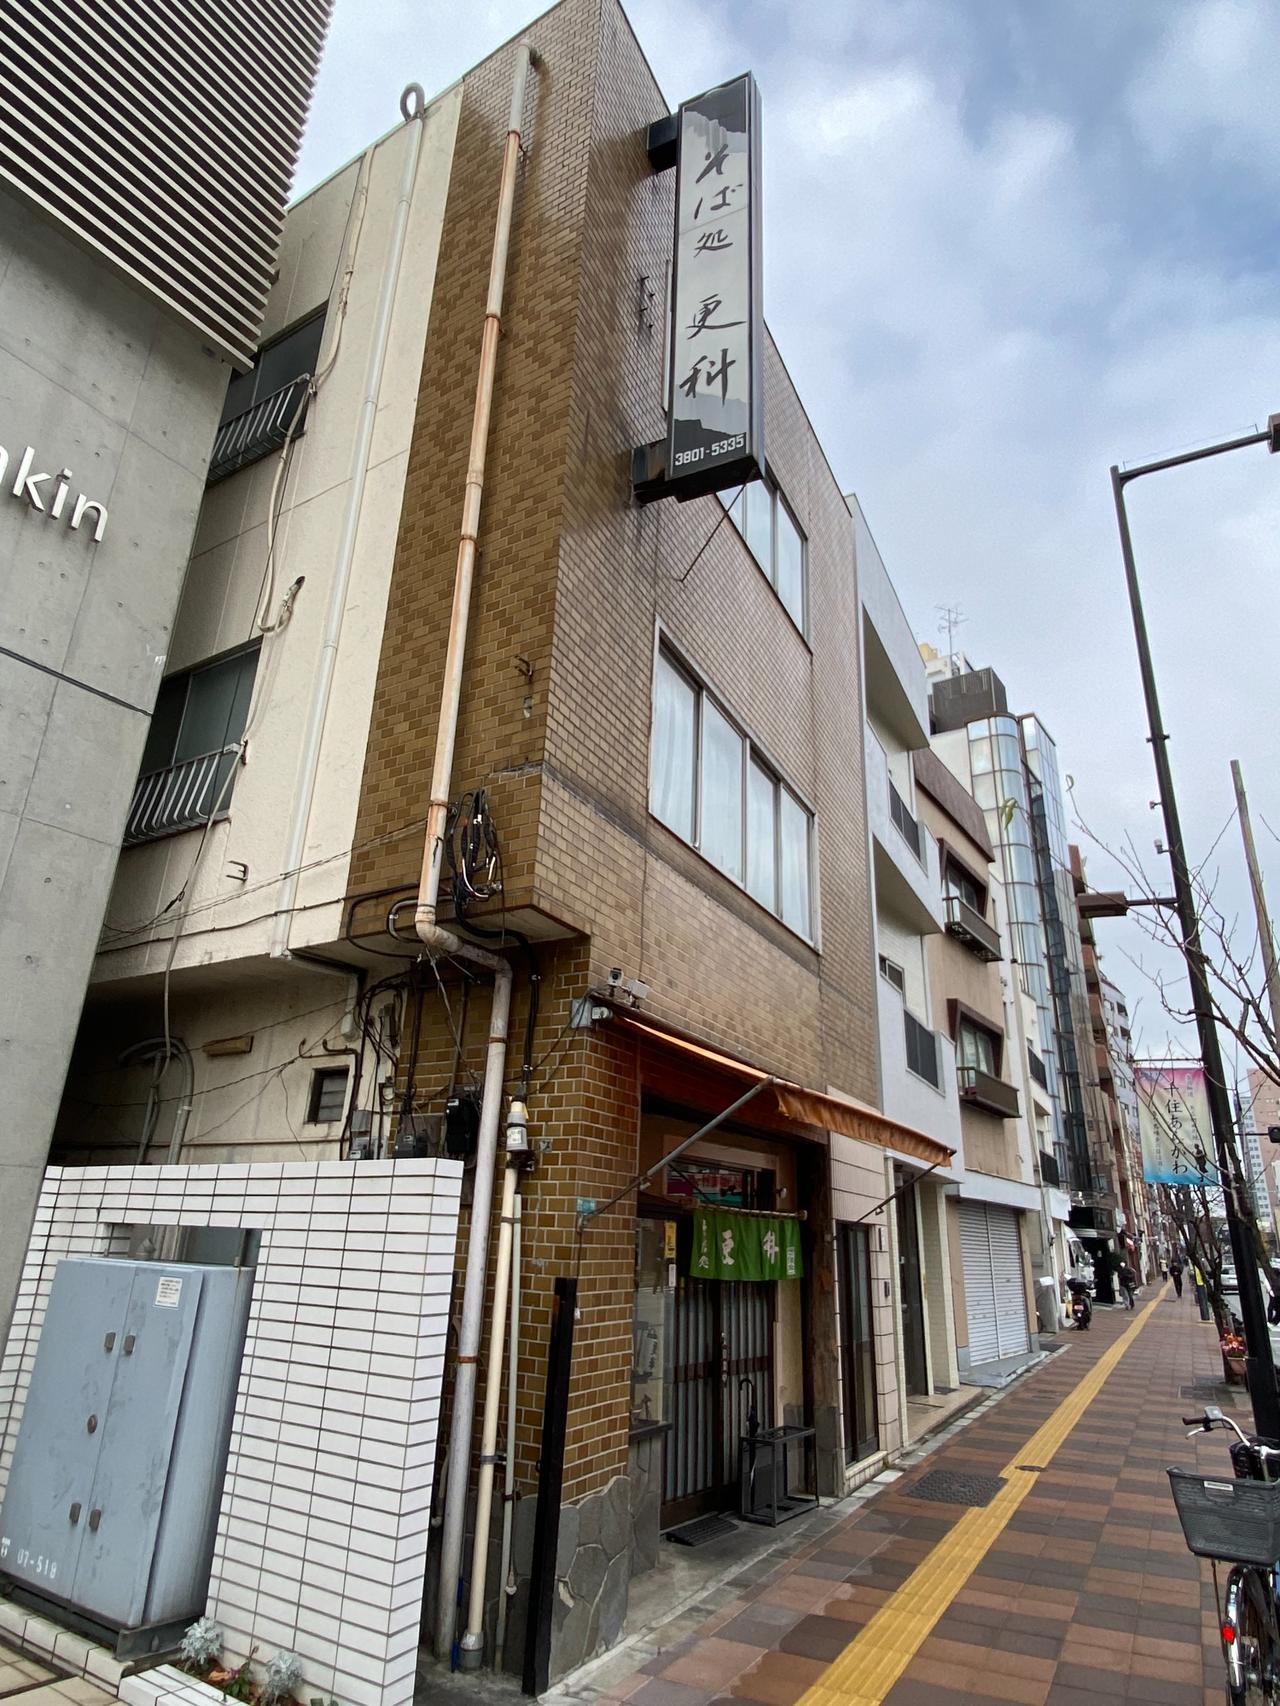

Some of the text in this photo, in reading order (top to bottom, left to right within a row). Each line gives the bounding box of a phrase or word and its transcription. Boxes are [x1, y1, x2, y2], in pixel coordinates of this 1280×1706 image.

[679, 143, 747, 407] そば処 更科
[674, 433, 745, 466] 3801-5335
